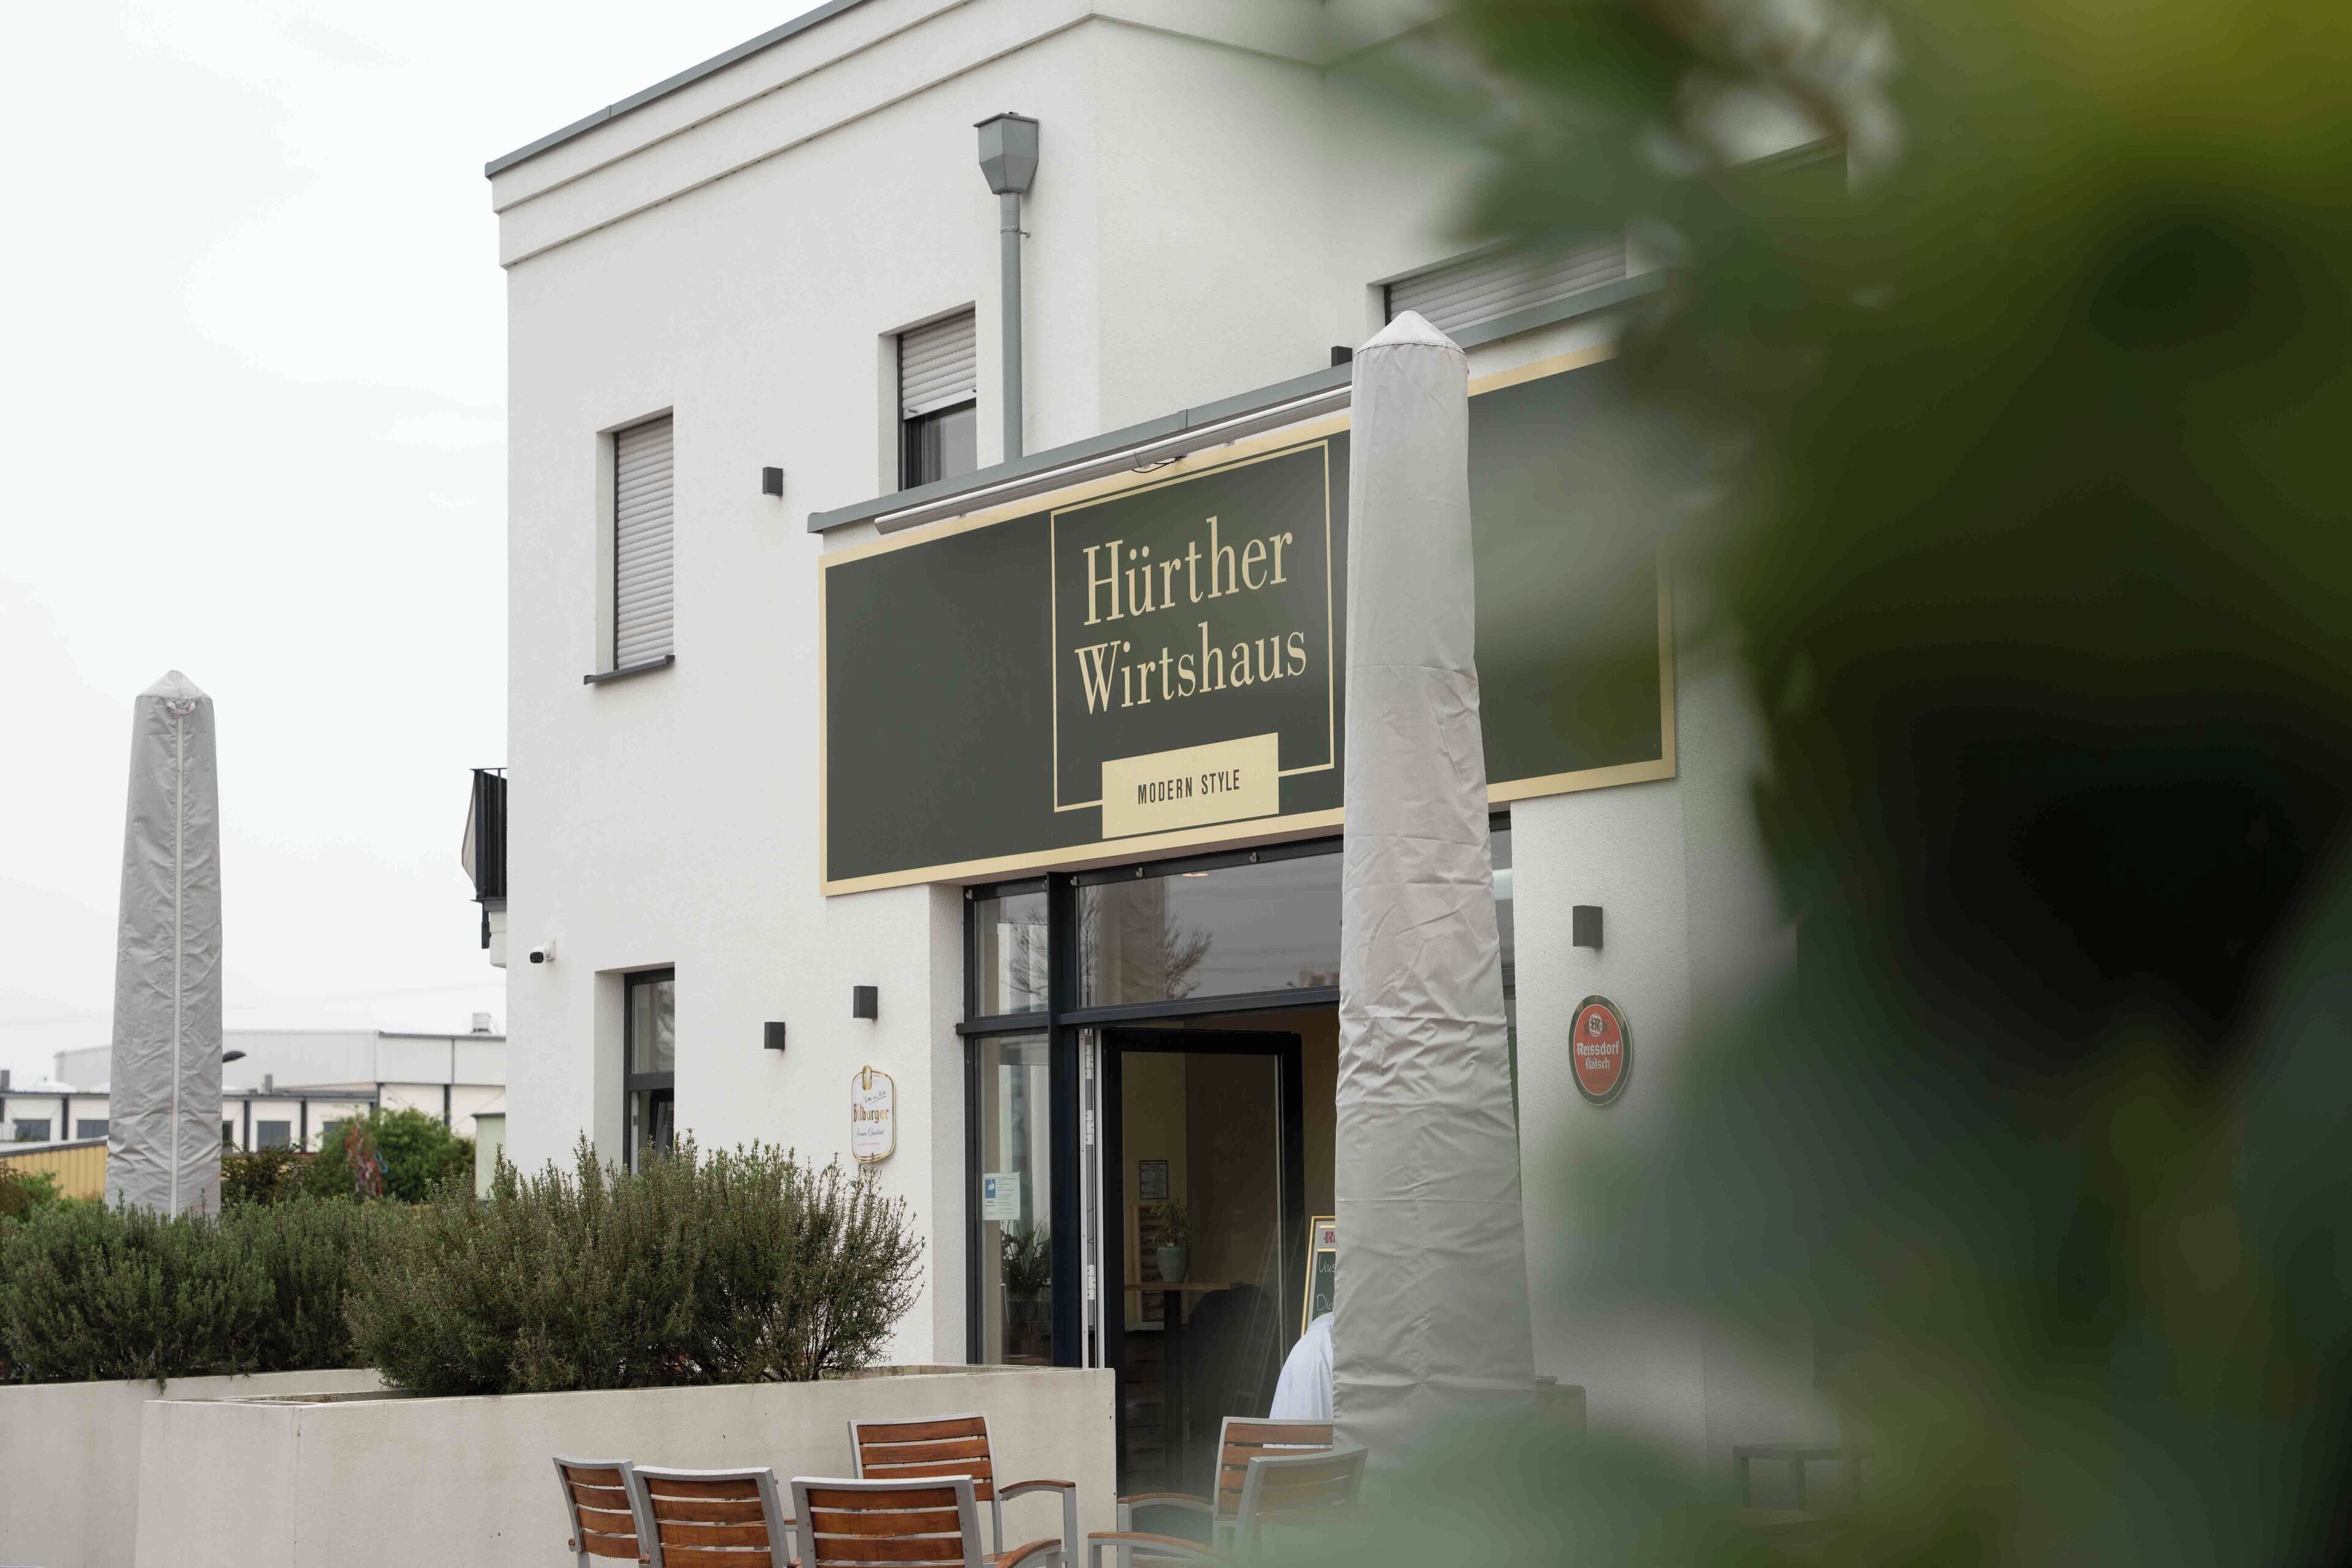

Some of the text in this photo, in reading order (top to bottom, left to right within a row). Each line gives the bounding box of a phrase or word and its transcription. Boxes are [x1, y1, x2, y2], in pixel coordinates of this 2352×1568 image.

[1083, 515, 1293, 626] Hürther
[1074, 621, 1306, 715] Wirtshaus
[1138, 769, 1240, 805] MODERN STYLE
[1577, 1041, 1619, 1055] Reissdorf
[1585, 1057, 1610, 1071] Kölsch
[853, 1103, 889, 1123] Bitburger
